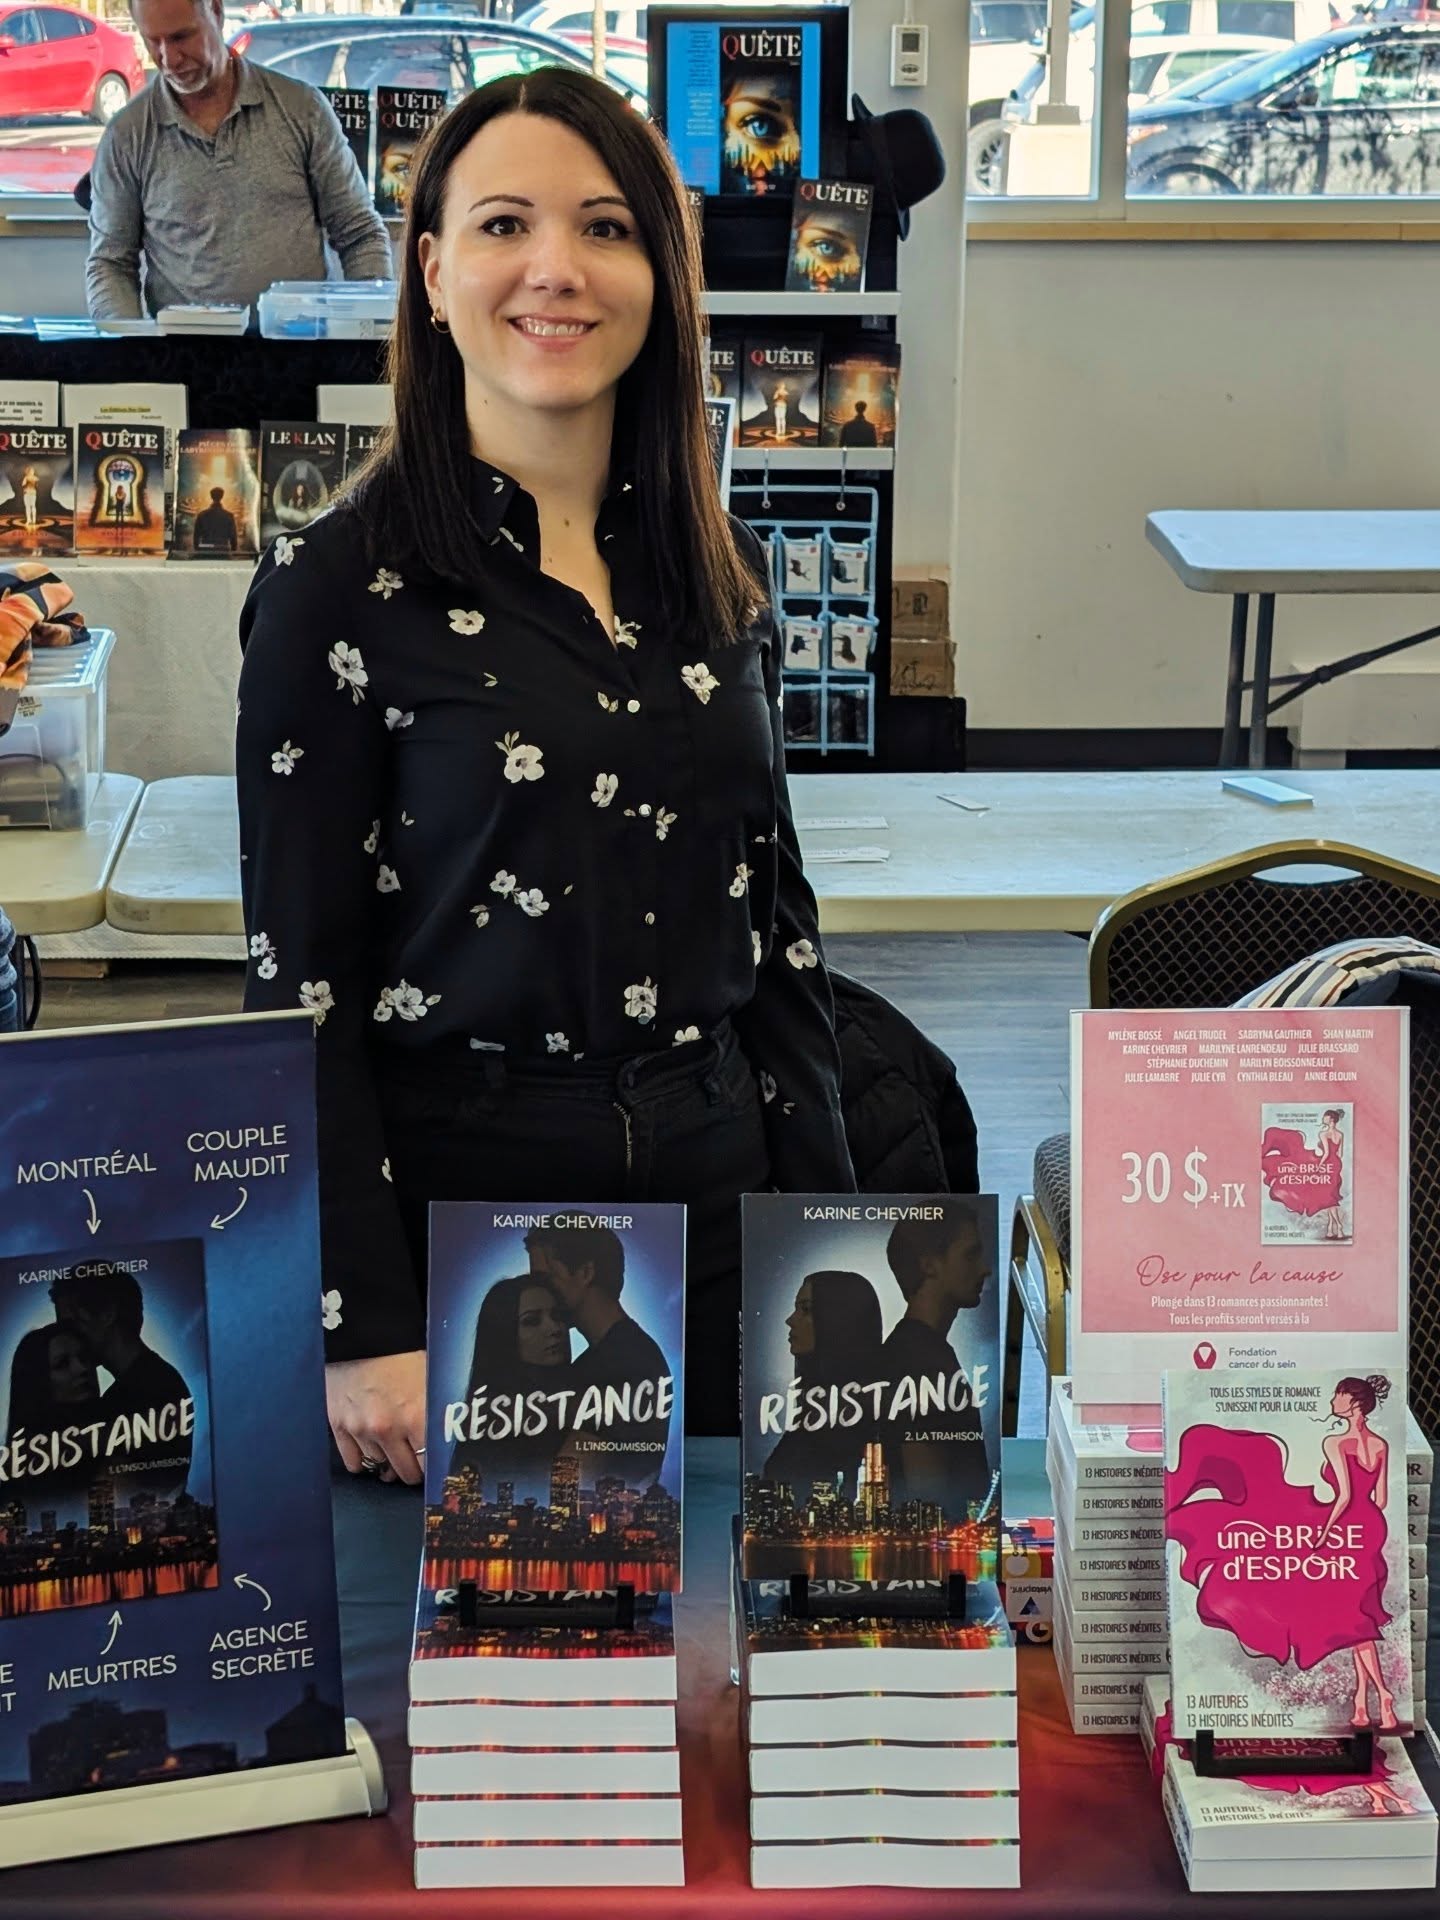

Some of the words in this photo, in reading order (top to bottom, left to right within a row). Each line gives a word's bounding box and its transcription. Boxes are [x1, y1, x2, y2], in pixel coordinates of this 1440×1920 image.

[722, 30, 802, 60] QUÊTE
[327, 91, 366, 109] ÊTE
[380, 91, 443, 110] QUÊTE
[381, 111, 438, 129] QUÊT
[801, 183, 869, 205] QUÊTE
[751, 346, 815, 367] QUÊTE
[0, 430, 67, 450] QUÊTE
[85, 429, 158, 450] QUÊTE
[270, 431, 291, 445] LE
[292, 432, 337, 446] KLAN
[1173, 1030, 1197, 1040] ANGEL
[1199, 1030, 1227, 1040] TRUDEL
[1238, 1029, 1273, 1040] SABRYNA
[1274, 1029, 1312, 1040] GAUTHIER
[1323, 1029, 1343, 1039] SHAN
[1345, 1029, 1374, 1039] MARTIN
[1122, 1044, 1150, 1055] KARINE
[1151, 1044, 1187, 1054] CHEVRIER
[1198, 1044, 1235, 1054] MARILYNE
[1298, 1043, 1318, 1054] JULIE
[1319, 1043, 1359, 1053] BRASSARD
[1146, 1056, 1187, 1069] STÉPHANIE
[1188, 1058, 1229, 1068] DUCHEMIN
[1239, 1058, 1272, 1068] MARILYN
[1273, 1057, 1334, 1068] BOISSONNEAULT
[1124, 1073, 1145, 1083] JULIE
[1145, 1072, 1180, 1083] LAMARRE
[1191, 1072, 1211, 1083] JULIE
[1211, 1072, 1226, 1082] CYR
[1237, 1072, 1268, 1082] CYNTHIA
[1269, 1072, 1293, 1082] BLEAU
[1304, 1072, 1328, 1081] ANNIE
[1328, 1072, 1357, 1081] BLOUIN
[186, 1125, 288, 1153] COUPLE
[16, 1150, 158, 1184] MONTRÉAL
[194, 1154, 290, 1183] MAUDIT
[1121, 1151, 1171, 1204] 30
[804, 1207, 861, 1220] KARINE
[865, 1207, 944, 1220] CHEVRIER
[493, 1214, 550, 1229] KARINE
[554, 1215, 633, 1229] CHEVRIER
[18, 1266, 72, 1285] KARINE
[75, 1258, 149, 1280] CHEVRIER
[1136, 1255, 1187, 1287] Ose
[1189, 1270, 1241, 1292] pour
[1249, 1261, 1276, 1284] la
[1281, 1269, 1344, 1284] cause
[1151, 1295, 1183, 1310] Plonge
[1183, 1296, 1205, 1308] dans
[1206, 1296, 1216, 1307] 13
[1216, 1297, 1259, 1308] romances
[1169, 1313, 1191, 1325] Tous
[1191, 1313, 1204, 1325] les
[1205, 1312, 1235, 1327] profits
[1235, 1313, 1264, 1325] seront
[1301, 1313, 1310, 1324] la
[1228, 1347, 1277, 1357] Fondation
[1228, 1360, 1260, 1369] cancer
[1262, 1359, 1275, 1369] du
[1277, 1359, 1296, 1369] sein
[1209, 1387, 1230, 1398] TOUS
[1231, 1387, 1245, 1398] LES
[1246, 1387, 1271, 1398] STYLES
[1272, 1387, 1283, 1397] DE
[1285, 1386, 1322, 1397] ROMANCE
[760, 1364, 990, 1435] RÉSISTANCE
[444, 1375, 675, 1443] RÉSISTANCE
[1215, 1401, 1258, 1412] S'UNISSENT
[1259, 1401, 1281, 1412] POUR
[1283, 1401, 1293, 1412] LA
[1294, 1401, 1318, 1412] CAUSE
[904, 1432, 914, 1441] 2.
[915, 1432, 929, 1441] LA
[930, 1431, 984, 1442] TRAHISON
[575, 1442, 582, 1451] 1.
[583, 1441, 666, 1452] L'INSOUMISSION
[1085, 1468, 1092, 1478] 13
[1094, 1467, 1131, 1478] HISTOIRES
[1083, 1499, 1090, 1509] 13
[1092, 1499, 1129, 1509] HISTOIRES
[1082, 1530, 1090, 1540] 13
[1091, 1530, 1129, 1540] HISTOIRES
[1217, 1526, 1266, 1550] une
[1080, 1560, 1087, 1570] 13
[1089, 1560, 1126, 1570] HISTOIRES
[1081, 1591, 1089, 1601] 13
[1090, 1591, 1128, 1601] HISTOIRES
[1081, 1623, 1089, 1633] 13
[1090, 1623, 1128, 1633] HISTOIRES
[209, 1620, 308, 1653] AGENCE
[211, 1647, 315, 1680] SECRÈTE
[1081, 1654, 1089, 1664] 13
[1090, 1654, 1128, 1664] HISTOIRES
[48, 1655, 178, 1691] MEURTRES
[1081, 1685, 1089, 1695] 13
[1090, 1685, 1128, 1695] HISTOIRES
[1186, 1696, 1196, 1709] 13
[1198, 1695, 1249, 1709] AUTEURES
[1083, 1716, 1089, 1725] 13
[1091, 1715, 1129, 1725] HISTOIRES
[1187, 1714, 1197, 1727] 13
[1199, 1713, 1249, 1727] HISTOIRES
[1251, 1710, 1294, 1727] INÉDITES
